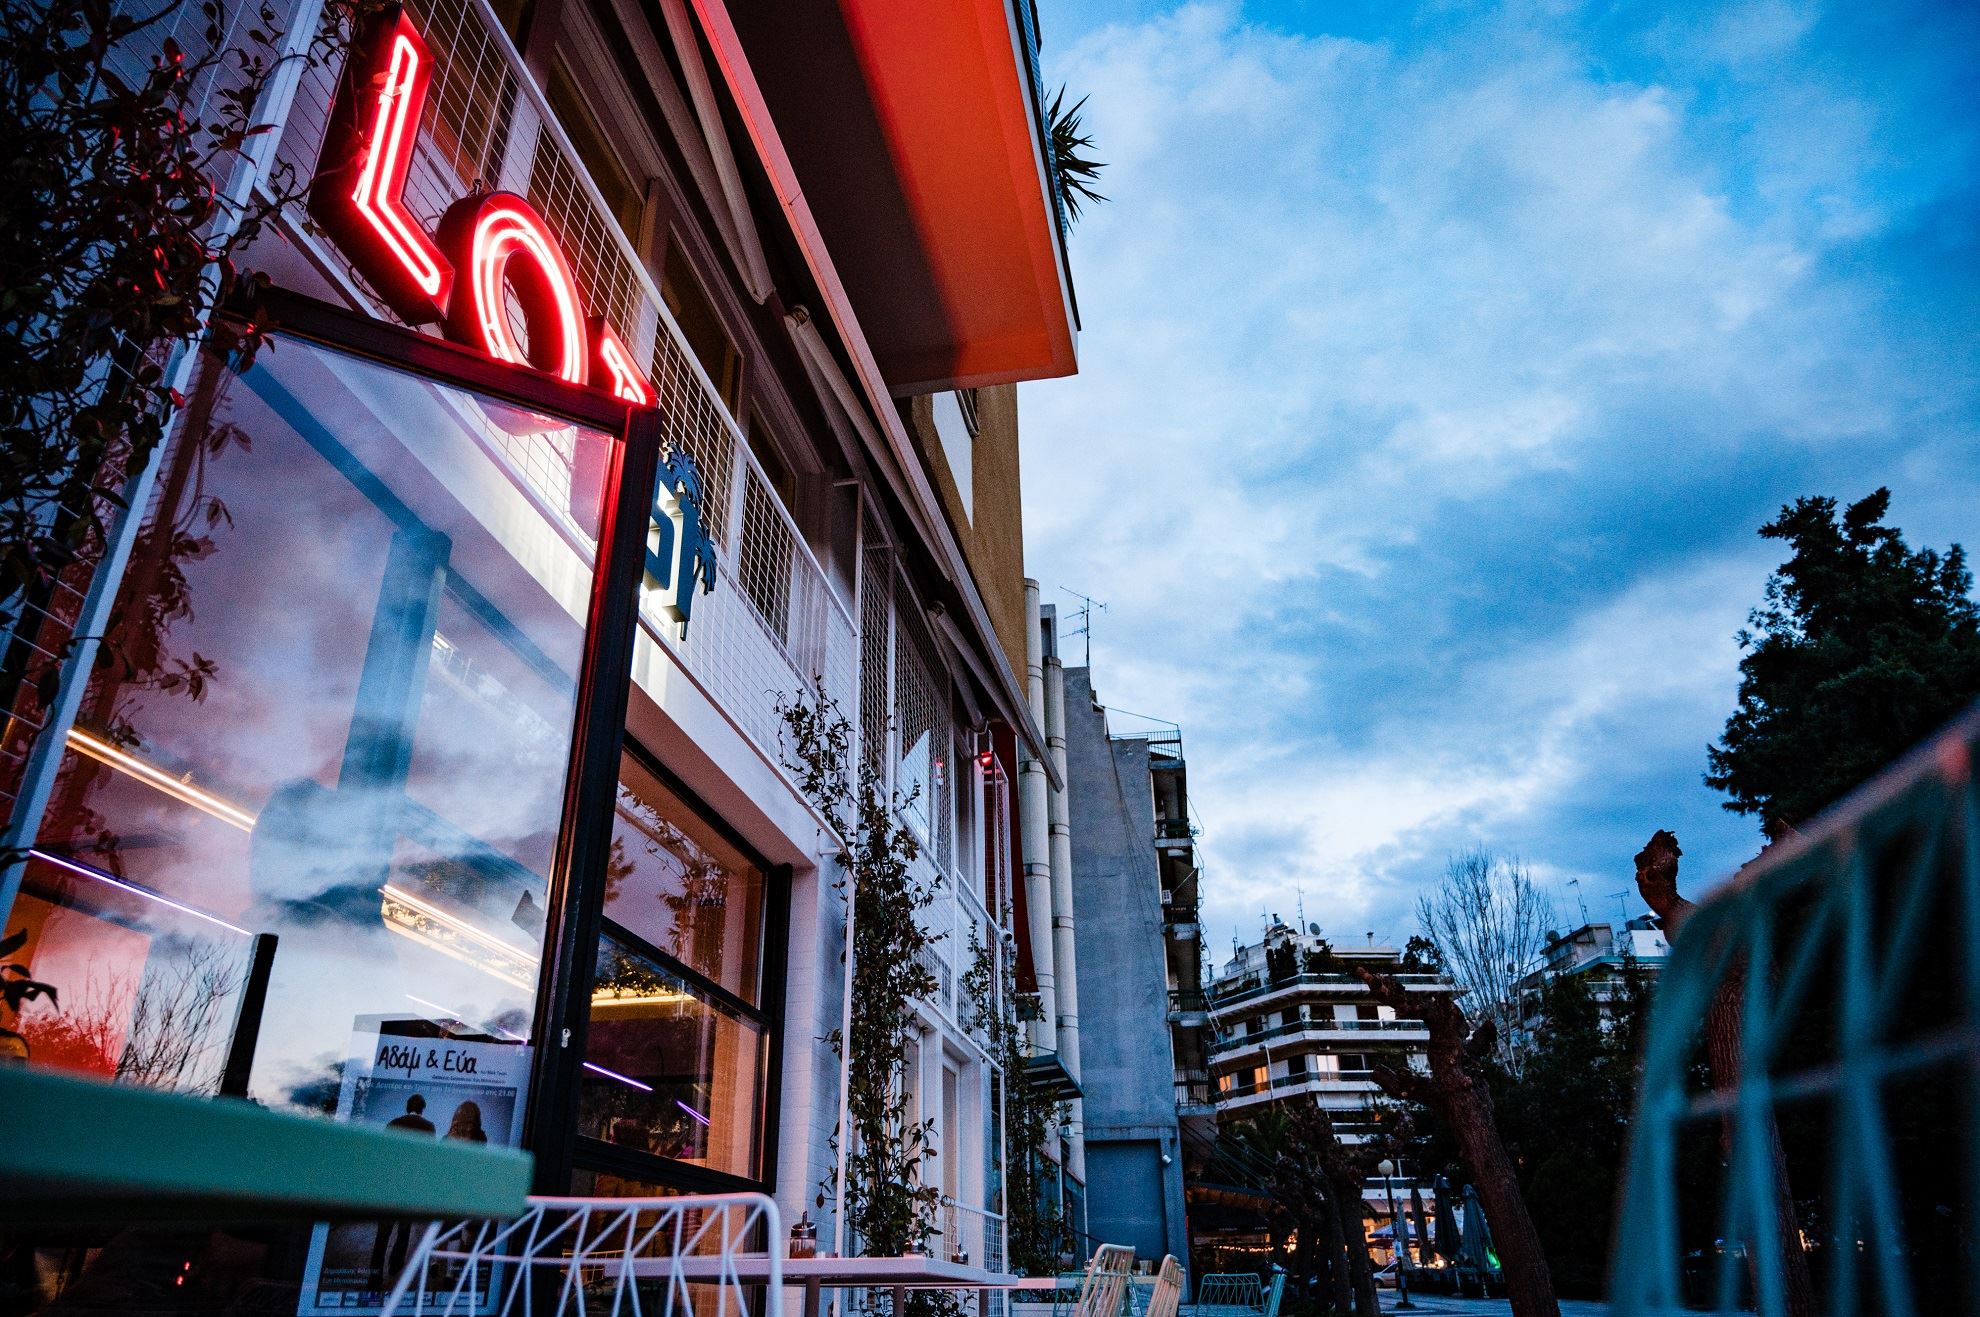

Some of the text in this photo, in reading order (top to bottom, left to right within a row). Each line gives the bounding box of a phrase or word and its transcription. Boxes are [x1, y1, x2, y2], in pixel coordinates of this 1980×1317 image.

[378, 1045, 478, 1078] Αδάμ & Εύα
